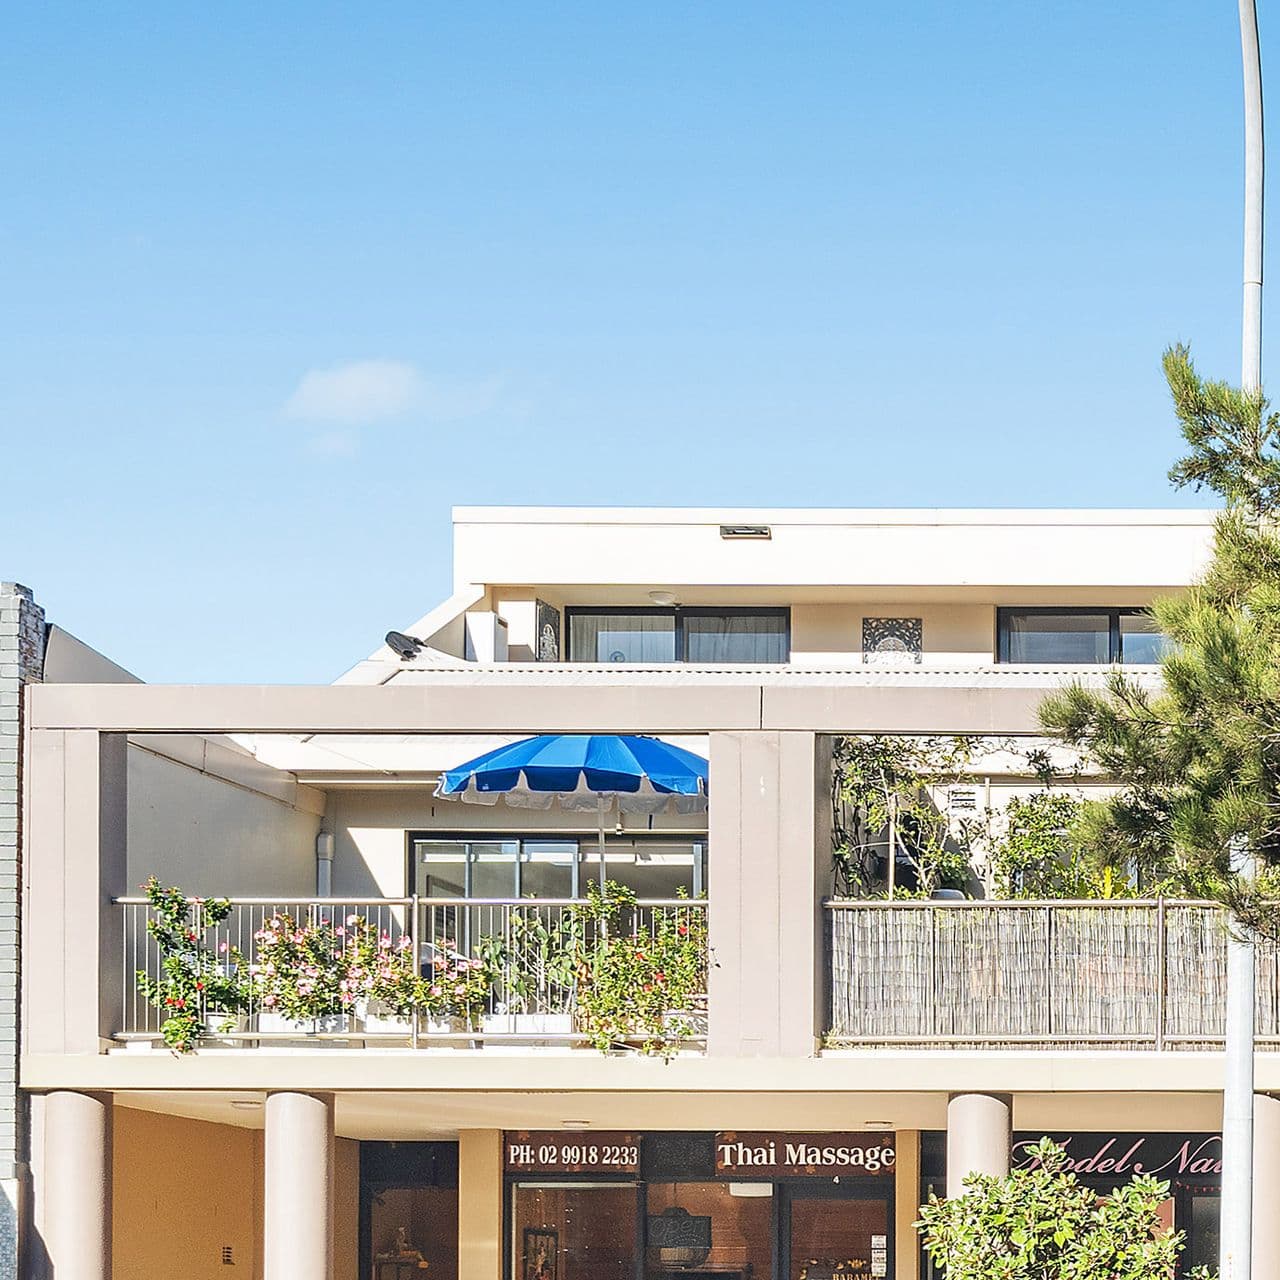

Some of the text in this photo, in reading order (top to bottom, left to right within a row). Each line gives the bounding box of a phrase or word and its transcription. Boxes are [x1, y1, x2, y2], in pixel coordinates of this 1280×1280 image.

[509, 1144, 638, 1165] PH: 02 9918 2233
[718, 1142, 895, 1171] Thai Massage
